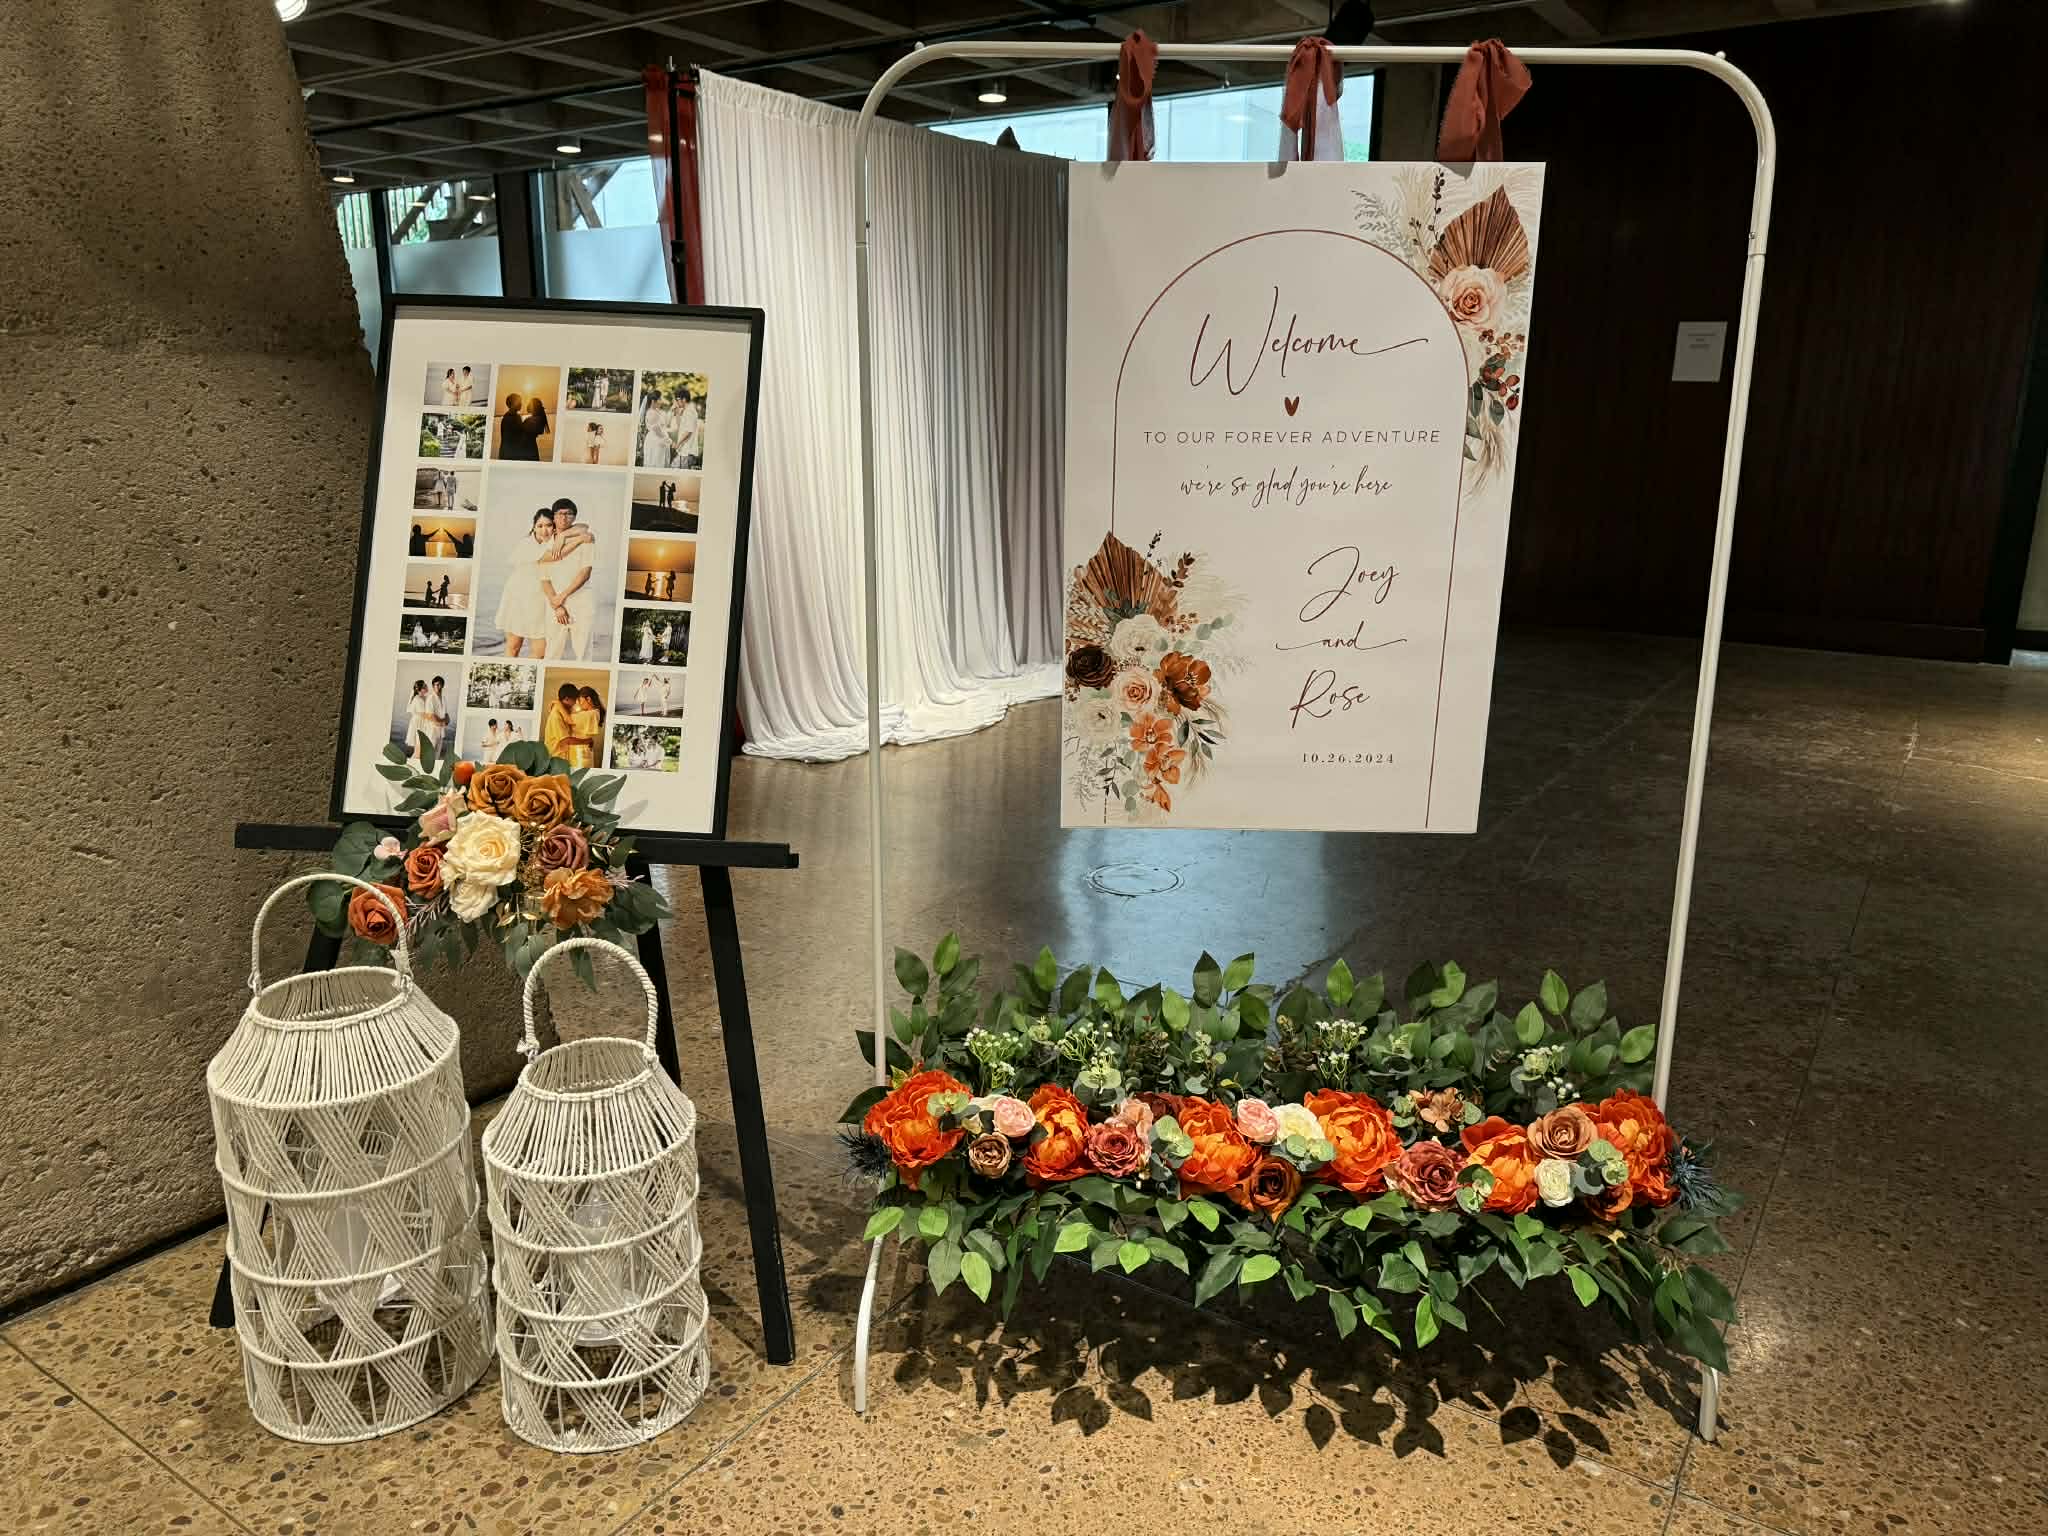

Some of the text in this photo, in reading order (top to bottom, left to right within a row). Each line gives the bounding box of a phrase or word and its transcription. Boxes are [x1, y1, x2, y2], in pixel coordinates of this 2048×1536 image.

[1190, 286, 1429, 396] Welcome
[1144, 430, 1441, 444] TO OUR FOREVER ADVENTURE
[1180, 464, 1393, 508] we're so glad you're here
[1299, 546, 1400, 622] Joey
[1275, 620, 1408, 651] and
[1289, 669, 1370, 729] Rose
[1302, 752, 1394, 764] 10.26.2024
